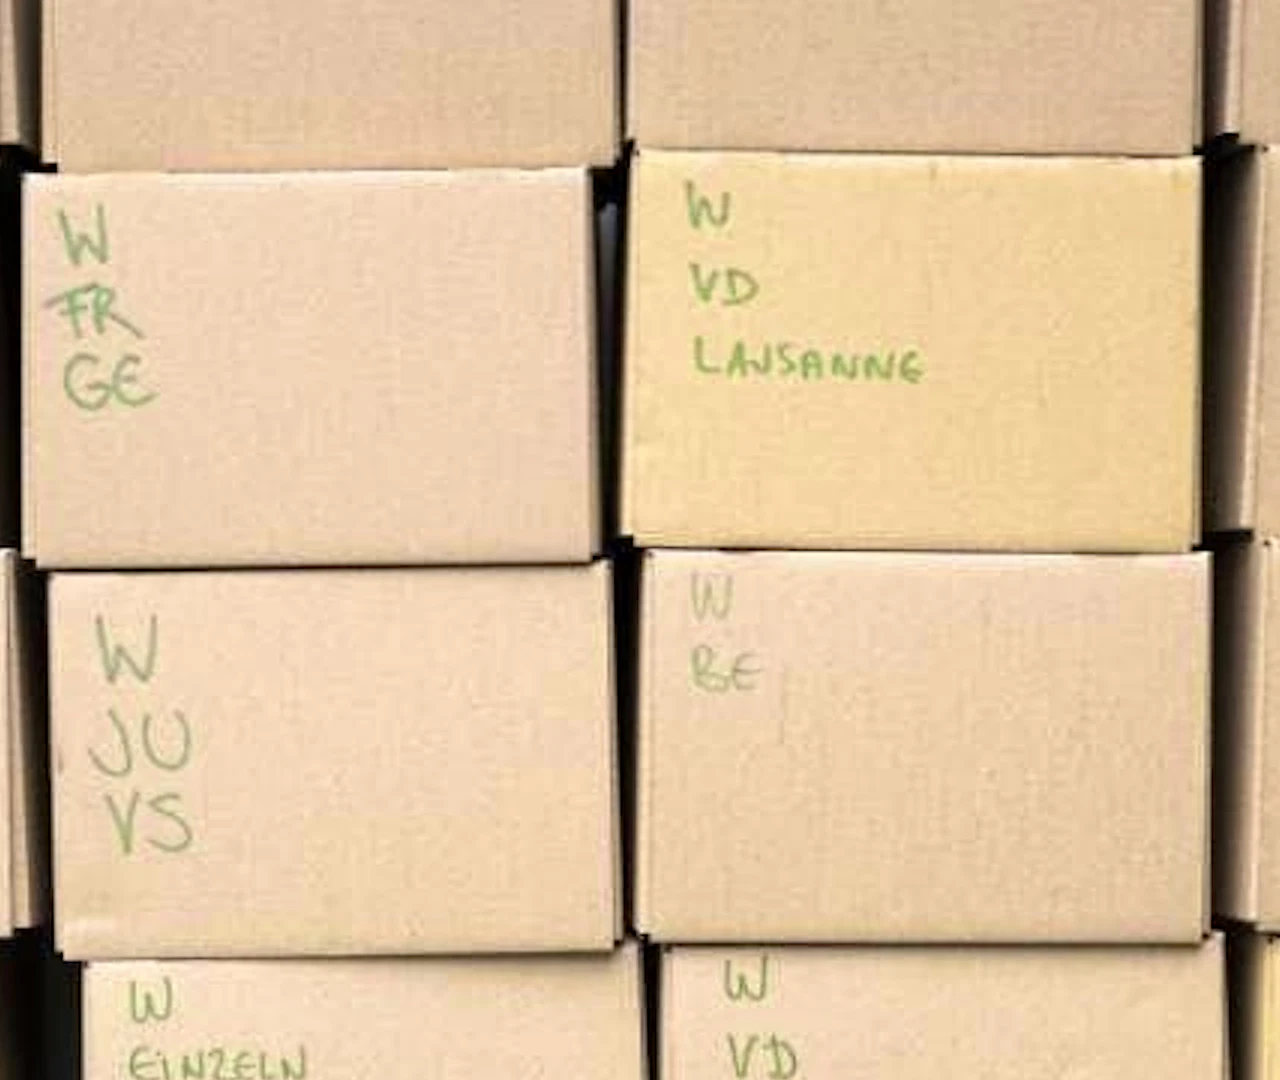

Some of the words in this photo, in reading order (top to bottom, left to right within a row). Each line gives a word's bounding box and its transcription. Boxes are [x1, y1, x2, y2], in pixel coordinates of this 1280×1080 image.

[685, 181, 730, 229] W
[56, 204, 109, 266] W
[690, 263, 759, 305] VD
[44, 282, 143, 338] FR
[63, 353, 157, 411] GE
[695, 337, 923, 383] LAUSANNE
[691, 573, 733, 621] W
[96, 616, 157, 684] W
[690, 645, 760, 693] BE
[88, 708, 192, 778] JU
[104, 791, 192, 856] VS
[723, 952, 769, 1001] W
[130, 978, 172, 1024] W
[728, 1035, 798, 1080] VD
